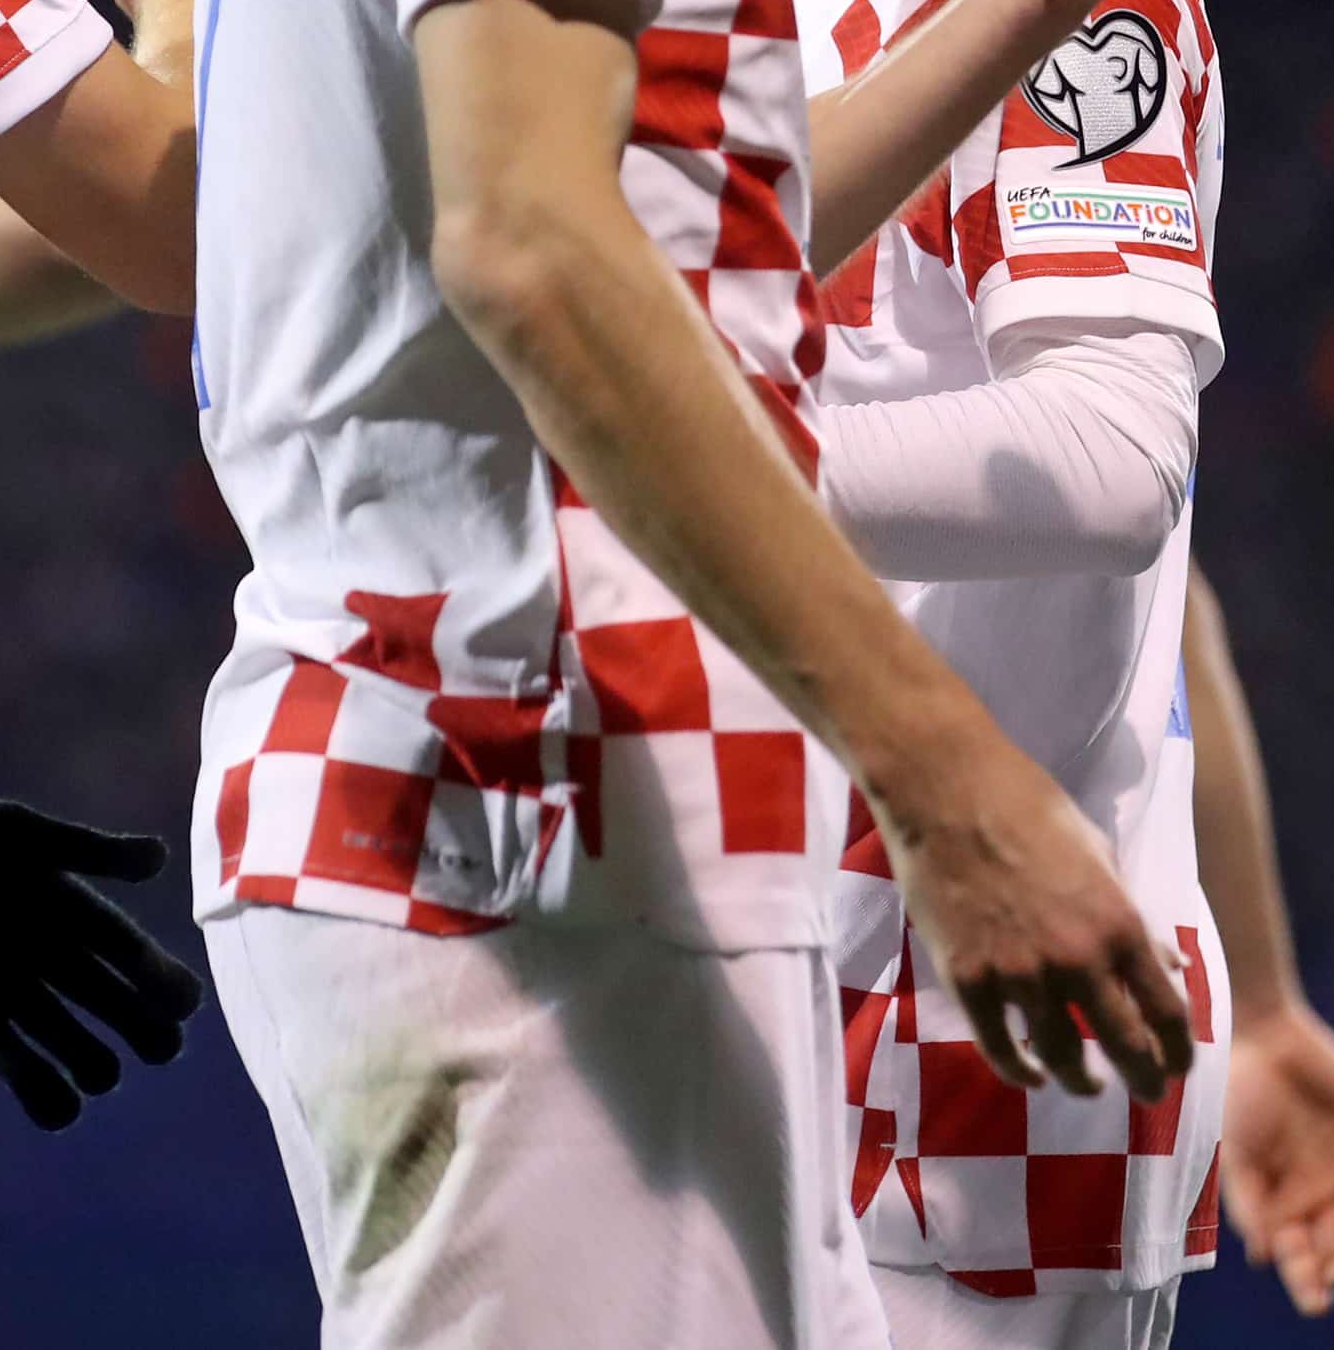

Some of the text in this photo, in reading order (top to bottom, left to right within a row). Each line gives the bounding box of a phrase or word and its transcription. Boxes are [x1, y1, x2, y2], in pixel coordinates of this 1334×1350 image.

[1007, 186, 1051, 202] UEFA
[1142, 227, 1193, 245] for children
